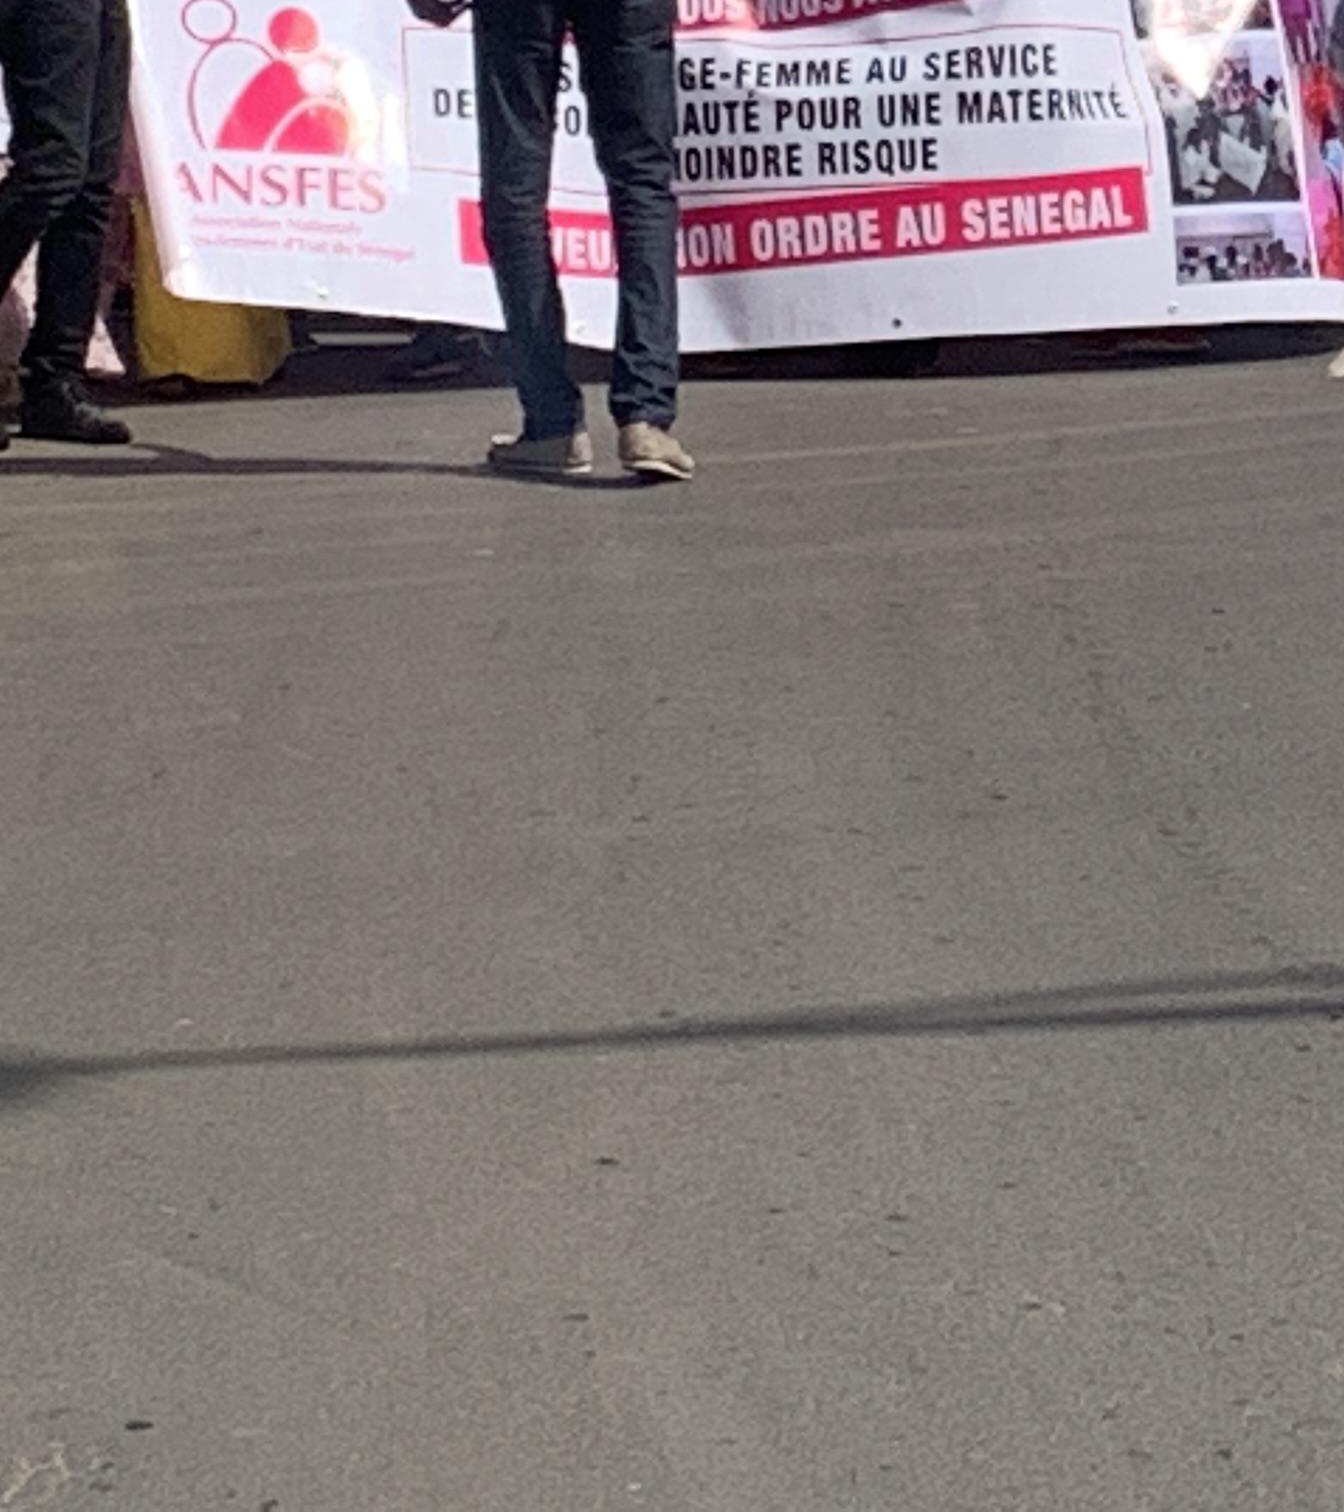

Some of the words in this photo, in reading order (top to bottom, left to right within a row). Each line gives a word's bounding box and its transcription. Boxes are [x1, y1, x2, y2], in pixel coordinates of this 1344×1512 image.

[678, 56, 852, 91] GE-FEMME
[865, 55, 908, 85] AU
[921, 42, 1058, 82] SERVICE
[774, 95, 863, 133] POUR
[876, 91, 943, 128] UNE
[957, 82, 1130, 125] MATERNITÉ
[817, 137, 939, 176] RISQUE
[176, 162, 387, 216] ANSFES
[749, 208, 882, 261] ORDRE
[894, 202, 947, 251] AU
[961, 184, 1133, 242] SENEGAL
